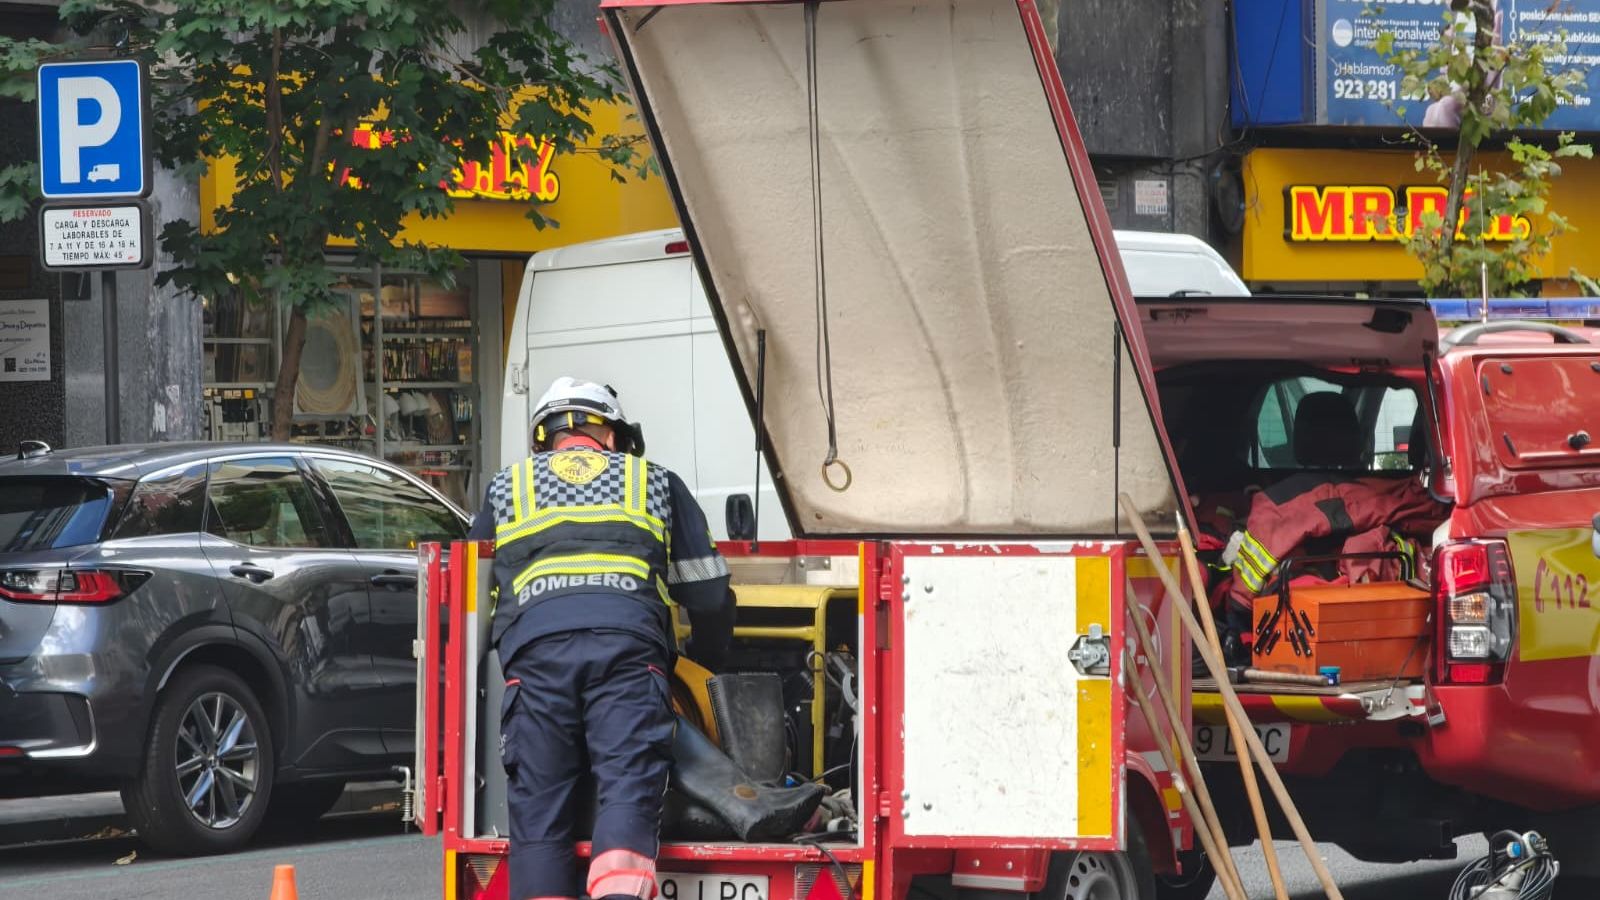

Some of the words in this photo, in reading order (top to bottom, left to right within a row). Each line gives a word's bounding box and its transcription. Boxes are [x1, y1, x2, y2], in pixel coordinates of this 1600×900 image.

[1334, 79, 1364, 99] 923
[1368, 80, 1396, 100] 281
[57, 76, 122, 183] P
[72, 209, 112, 218] RESERVADO
[54, 220, 79, 229] CARGA
[83, 220, 88, 228] Y
[91, 219, 130, 228] DESCARGA
[62, 230, 109, 240] LABORABLES
[112, 229, 123, 238] DE
[84, 241, 95, 249] DE
[62, 252, 89, 261] TIEMPO
[518, 573, 638, 607] BOMBERO
[1551, 573, 1591, 610] 112
